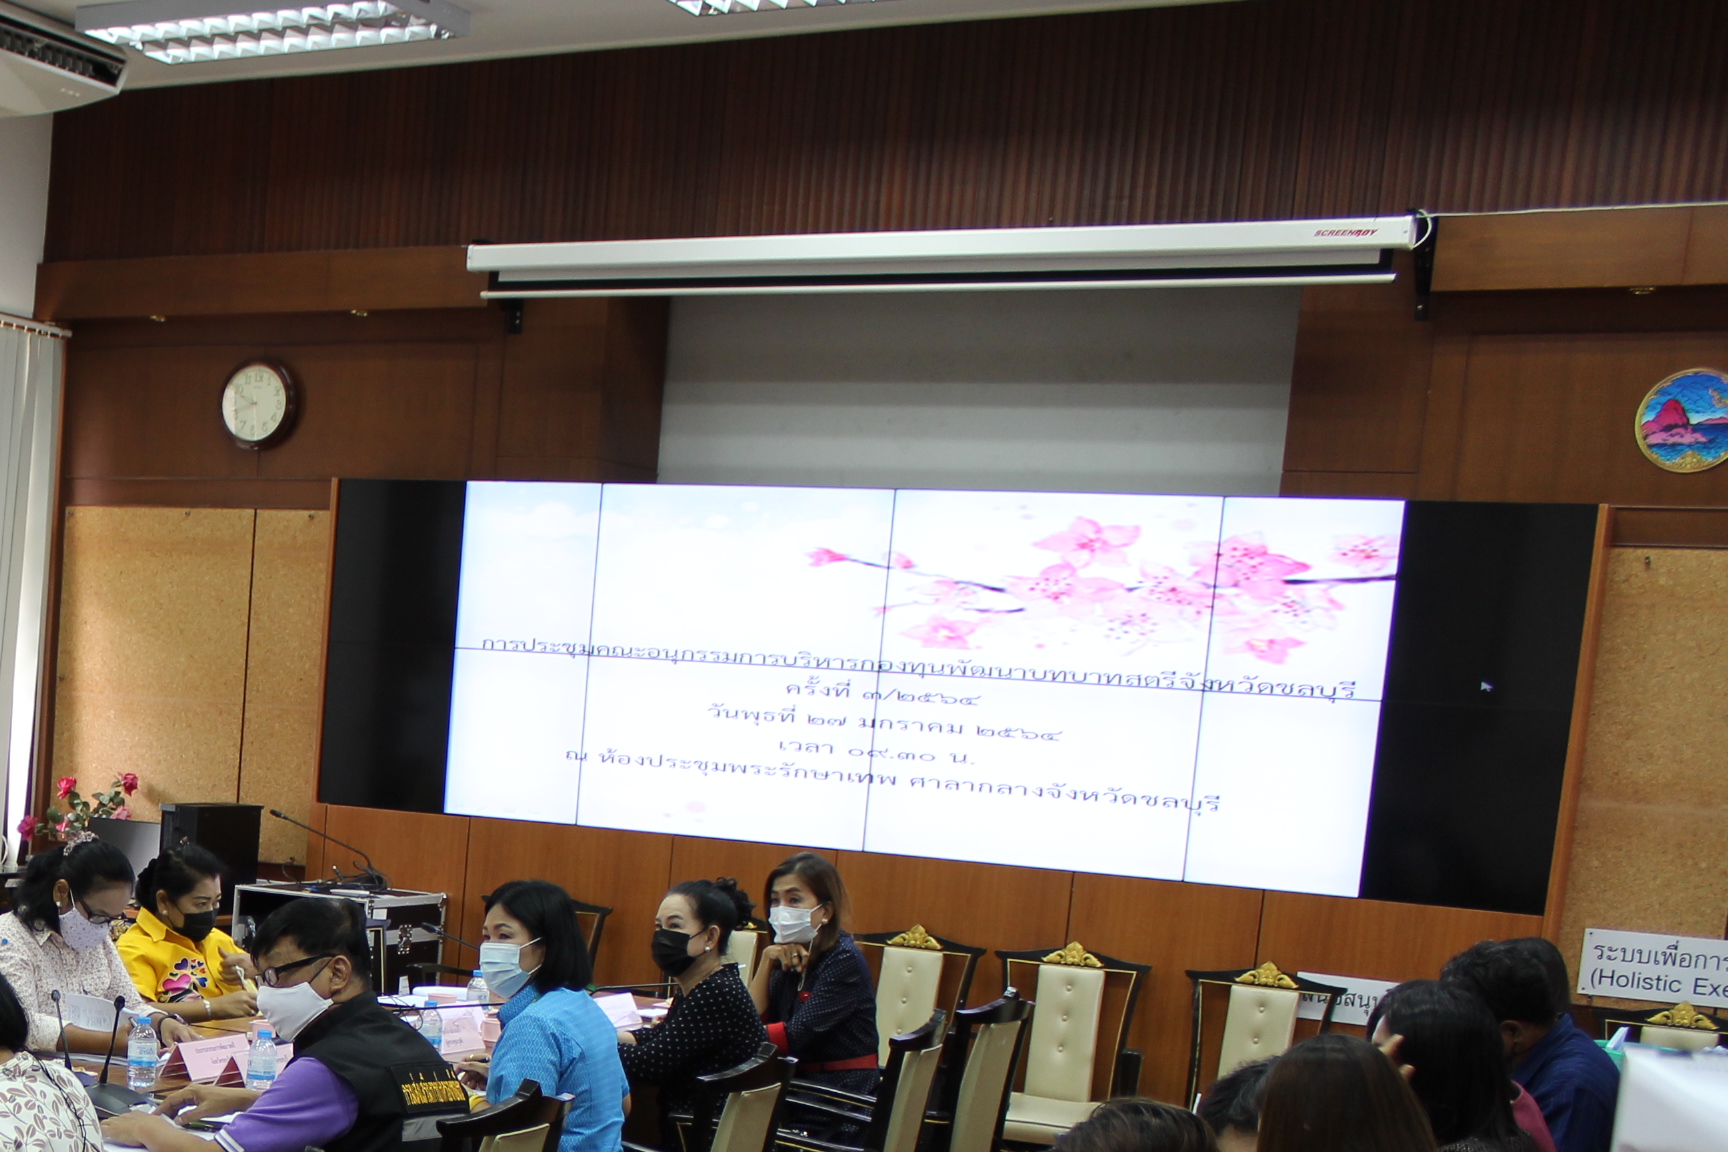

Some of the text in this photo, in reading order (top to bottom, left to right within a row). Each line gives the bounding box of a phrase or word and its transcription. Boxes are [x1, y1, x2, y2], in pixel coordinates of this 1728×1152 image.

[786, 675, 851, 698] ครั้งที่
[707, 703, 1063, 742] วันพุธที่ ๒๗ มกราคม ๒๕๖๔
[779, 740, 834, 754] เวลา
[950, 752, 975, 765] น.
[566, 749, 588, 762] ณ
[910, 776, 1221, 816] ศาลากลางจังหวัดชลบุรี
[1590, 967, 1682, 993] (Holistic
